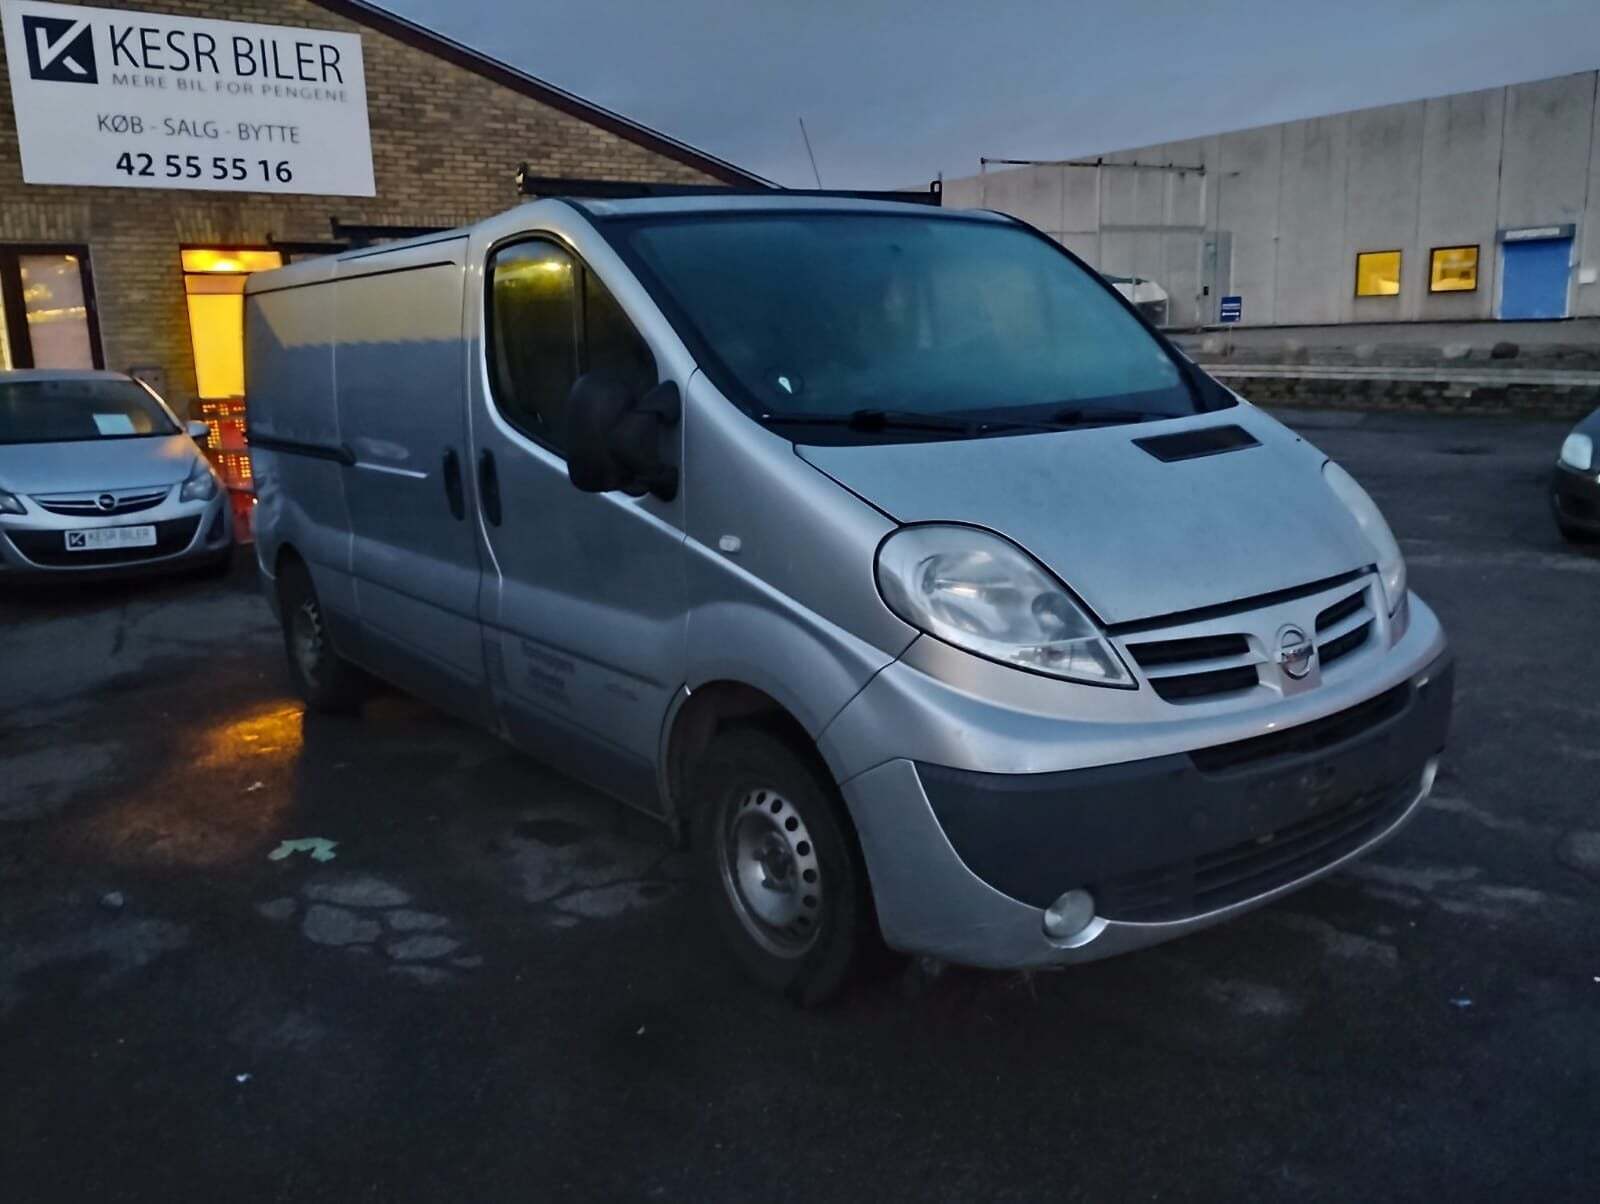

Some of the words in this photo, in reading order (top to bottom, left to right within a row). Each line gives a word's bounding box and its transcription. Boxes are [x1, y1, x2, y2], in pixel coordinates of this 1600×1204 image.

[109, 25, 219, 75] KESR
[233, 36, 345, 84] BILER
[112, 73, 168, 89] MERE
[177, 77, 208, 93] BIL
[215, 80, 254, 96] FOR
[261, 85, 348, 103] PENGENE
[97, 113, 144, 134] KØB
[164, 118, 219, 140] SALG
[238, 122, 301, 145] BYTTE
[116, 152, 155, 177] 42
[166, 154, 202, 179] 55
[213, 157, 248, 181] 55
[258, 160, 293, 183] 16
